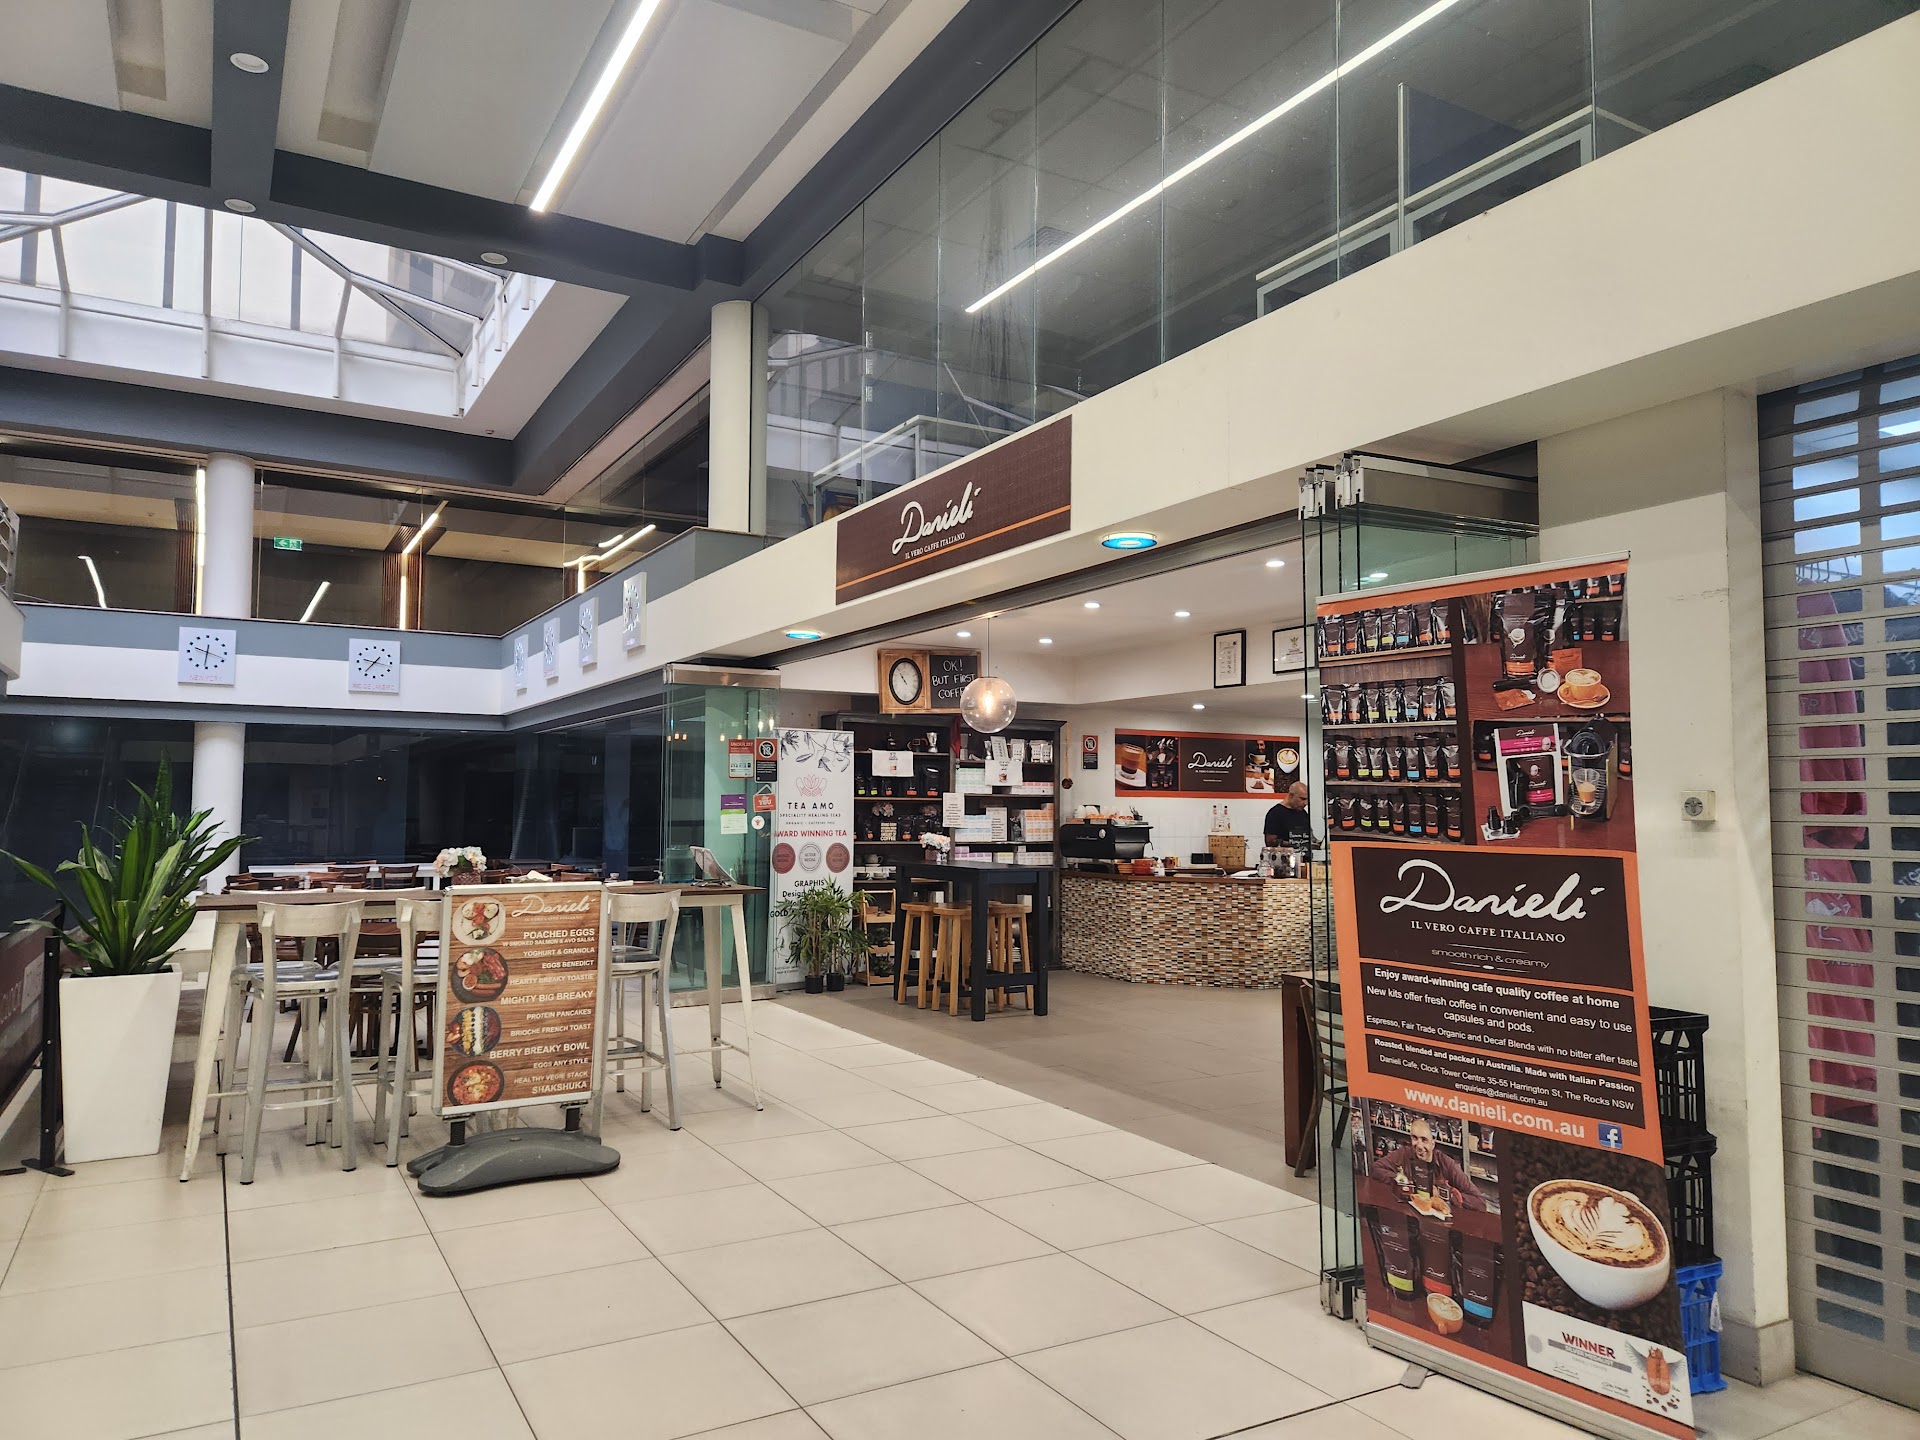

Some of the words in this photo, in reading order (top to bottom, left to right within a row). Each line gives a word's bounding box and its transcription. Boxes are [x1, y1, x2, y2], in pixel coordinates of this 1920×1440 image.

[910, 548, 924, 558] VERO
[924, 542, 940, 553] CAFFE
[940, 532, 966, 547] ITALIANO
[932, 675, 950, 687] BUT
[938, 686, 965, 700] COFFE
[788, 802, 806, 810] TEA
[812, 802, 834, 810] AMO
[774, 830, 799, 838] AWARD
[794, 880, 825, 888] GRAPHIS
[770, 910, 788, 918] GOLD
[523, 929, 568, 940] POACHED
[570, 928, 596, 937] EGGS
[1410, 920, 1422, 930] IL
[1424, 922, 1456, 933] VERO
[1458, 925, 1497, 937] CAFFE
[1500, 929, 1566, 943] ITALIANO
[534, 938, 558, 946] SALMON
[523, 950, 556, 958] YOGHURT
[563, 947, 596, 955] GRANOLA
[1431, 949, 1472, 959] smooth
[1472, 952, 1494, 962] rich
[1494, 954, 1504, 963] &
[1504, 957, 1550, 969] creamy
[562, 960, 595, 968] BENEDICT
[510, 978, 538, 986] HEARTY
[538, 976, 566, 984] BREAKY
[1374, 967, 1400, 982] Enjoy
[1402, 972, 1470, 992] award-winning
[1472, 982, 1494, 994] cafe
[1496, 985, 1532, 1000] quality
[1534, 990, 1570, 1003] coffee
[1572, 995, 1584, 1005] at
[1586, 995, 1620, 1009] home
[500, 994, 538, 1006] MIGHTY
[538, 993, 554, 1002] BIG
[556, 990, 594, 1000] BREAKY
[526, 1012, 556, 1020] PROTEIN
[556, 1008, 592, 1018] PANCAKES
[1366, 986, 1387, 996] New
[1388, 988, 1402, 999] kits
[1404, 992, 1423, 1002] offer
[1424, 993, 1447, 1006] fresh
[1448, 999, 1477, 1011] coffee
[1479, 1002, 1488, 1012] in
[1490, 1005, 1544, 1021] convenient
[1546, 1013, 1567, 1024] and
[1570, 1016, 1597, 1030] easy
[1599, 1018, 1610, 1029] to
[1613, 1023, 1633, 1033] use
[1444, 1011, 1485, 1026] capsules
[1486, 1018, 1506, 1029] and
[1508, 1021, 1535, 1033] pods.
[510, 1028, 540, 1037] BRIOCHE
[542, 1025, 568, 1034] FRENCH
[569, 1023, 592, 1031] TOAST
[1366, 1014, 1400, 1028] Espresso,
[1402, 1020, 1415, 1030] Fair
[1416, 1023, 1436, 1034] Trade
[1438, 1027, 1466, 1040] Organic
[1468, 1032, 1482, 1042] and
[1483, 1035, 1507, 1046] Decaf
[1508, 1039, 1536, 1052] Blends
[1537, 1044, 1554, 1054] with
[1556, 1048, 1568, 1056] no
[1570, 1048, 1592, 1060] bitter
[1594, 1052, 1616, 1064] after
[1617, 1056, 1638, 1068] taste
[490, 1048, 522, 1060] BERRY
[524, 1044, 562, 1056] BREAKY
[563, 1042, 590, 1052] BOWL
[552, 1060, 568, 1068] ANY
[568, 1058, 589, 1066] STYLE
[1374, 1038, 1405, 1052] Roasted,
[1405, 1044, 1432, 1056] blended
[1434, 1050, 1448, 1060] and
[1448, 1054, 1476, 1066] packed
[1476, 1058, 1484, 1066] in
[1486, 1060, 1524, 1074] Australia.
[1524, 1066, 1548, 1078] Made
[1548, 1071, 1568, 1081] with
[1569, 1074, 1597, 1086] Italian
[1598, 1079, 1635, 1093] Passion
[514, 1076, 546, 1084] HEALTHY
[566, 1070, 588, 1078] STACK
[1380, 1054, 1402, 1066] Danieli
[1402, 1059, 1420, 1070] Cafe,
[1420, 1063, 1439, 1074] Clock
[1440, 1067, 1461, 1078] Tower
[1462, 1072, 1486, 1083] Centre
[1487, 1076, 1509, 1088] 35-55
[1510, 1080, 1550, 1096] Harrington
[1564, 1090, 1582, 1101] The
[1582, 1094, 1610, 1106] Rocks
[1612, 1098, 1635, 1111] NSW
[532, 1080, 588, 1095] SHAKSHUKA
[1454, 1082, 1548, 1107] enquiries@danieli.com.au
[1404, 1088, 1585, 1139] www.danieli.com.au
[1562, 1332, 1616, 1360] WINNER
